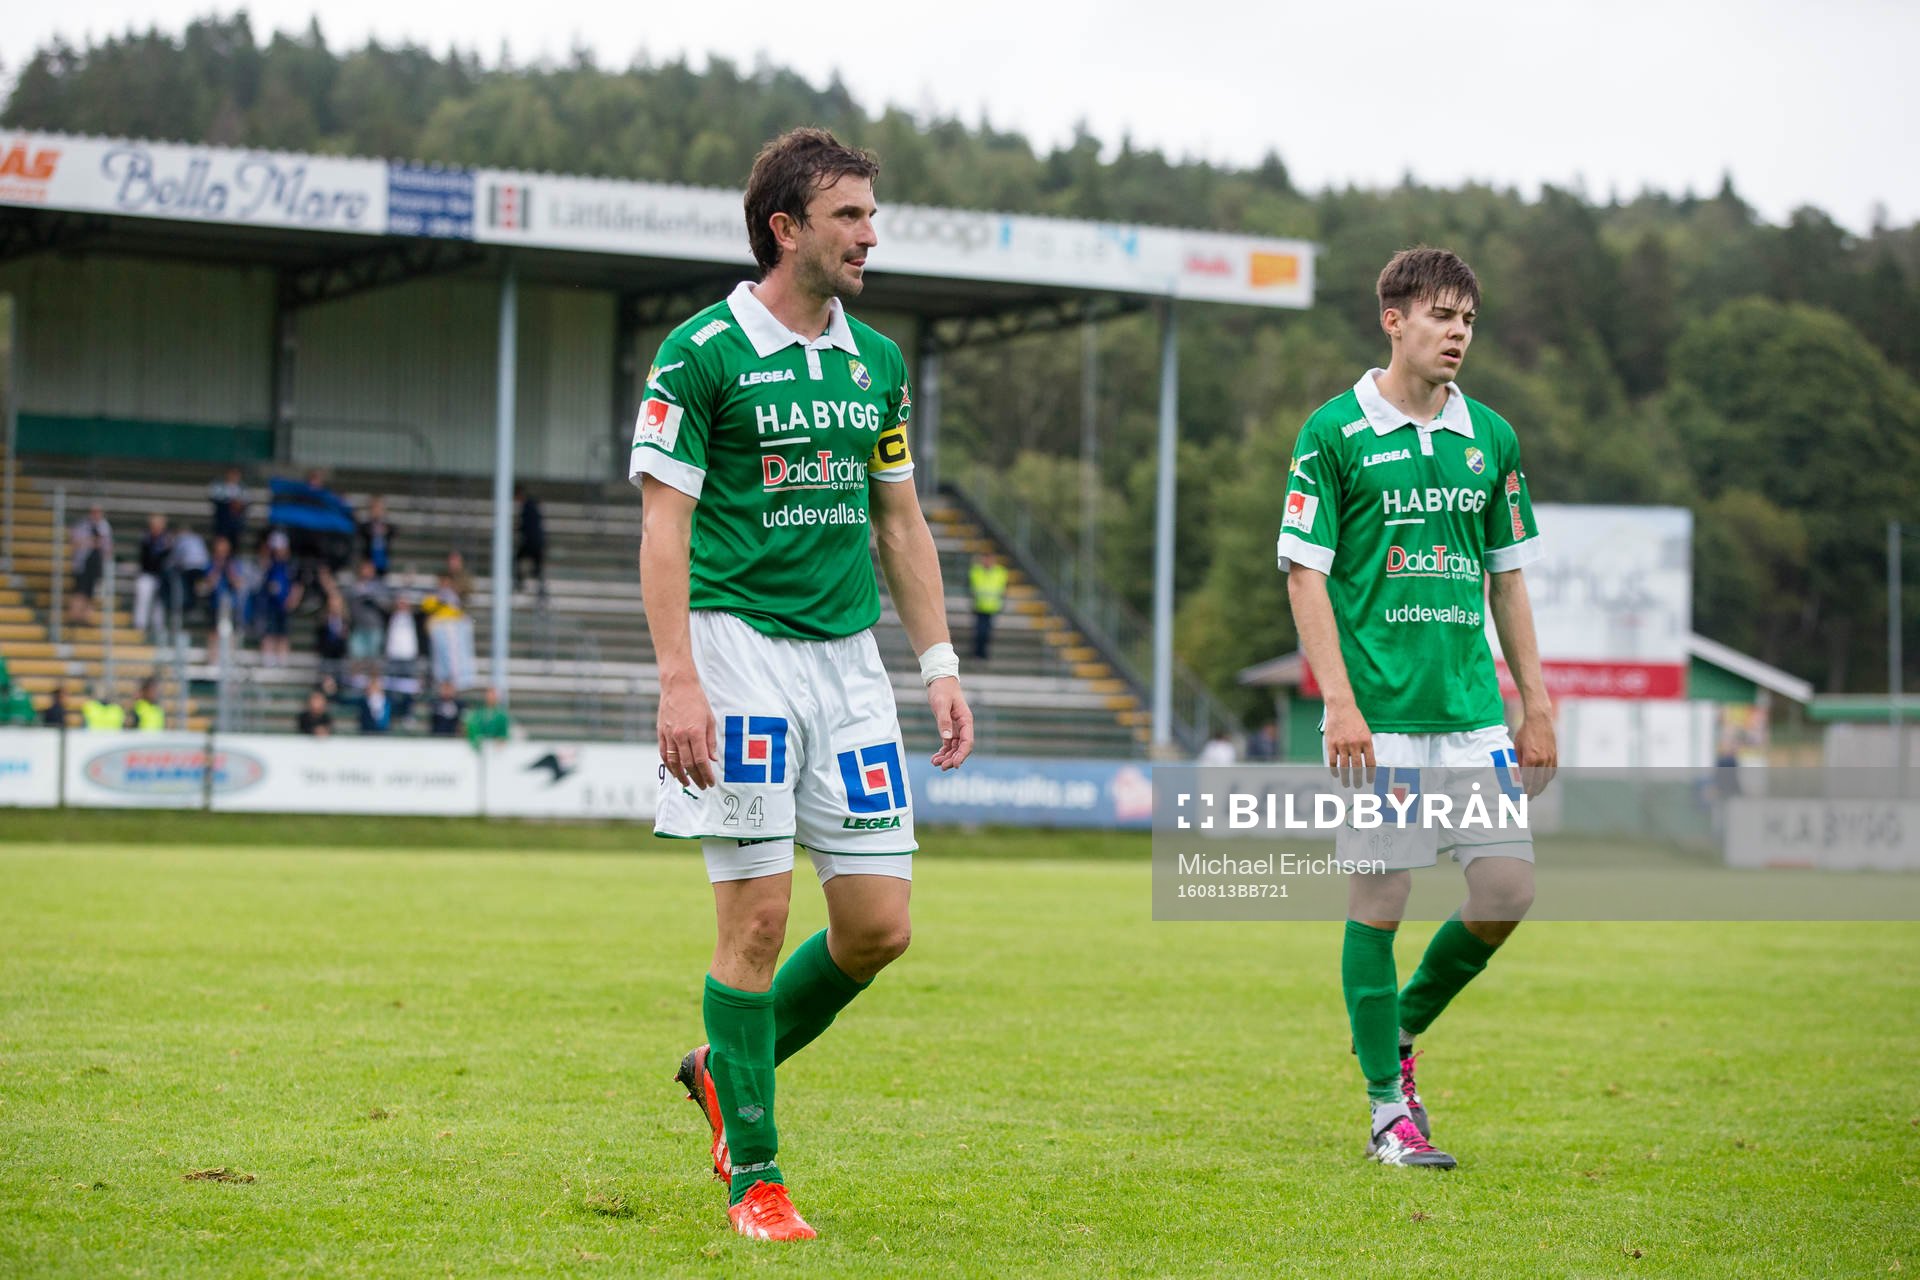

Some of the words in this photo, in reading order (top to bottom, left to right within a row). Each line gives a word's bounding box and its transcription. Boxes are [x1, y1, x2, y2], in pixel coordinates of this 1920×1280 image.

[740, 369, 796, 386] LEGEA
[812, 400, 879, 432] BYGG
[878, 433, 906, 463] C
[1363, 449, 1411, 467] LEGEA
[763, 503, 867, 528] uddevalla.s
[1386, 545, 1480, 577] DalaTrähus
[1385, 604, 1480, 626] uddevalla.se
[723, 795, 764, 827] 24
[842, 816, 901, 829] LEGEA
[731, 1160, 777, 1176] EGEA
